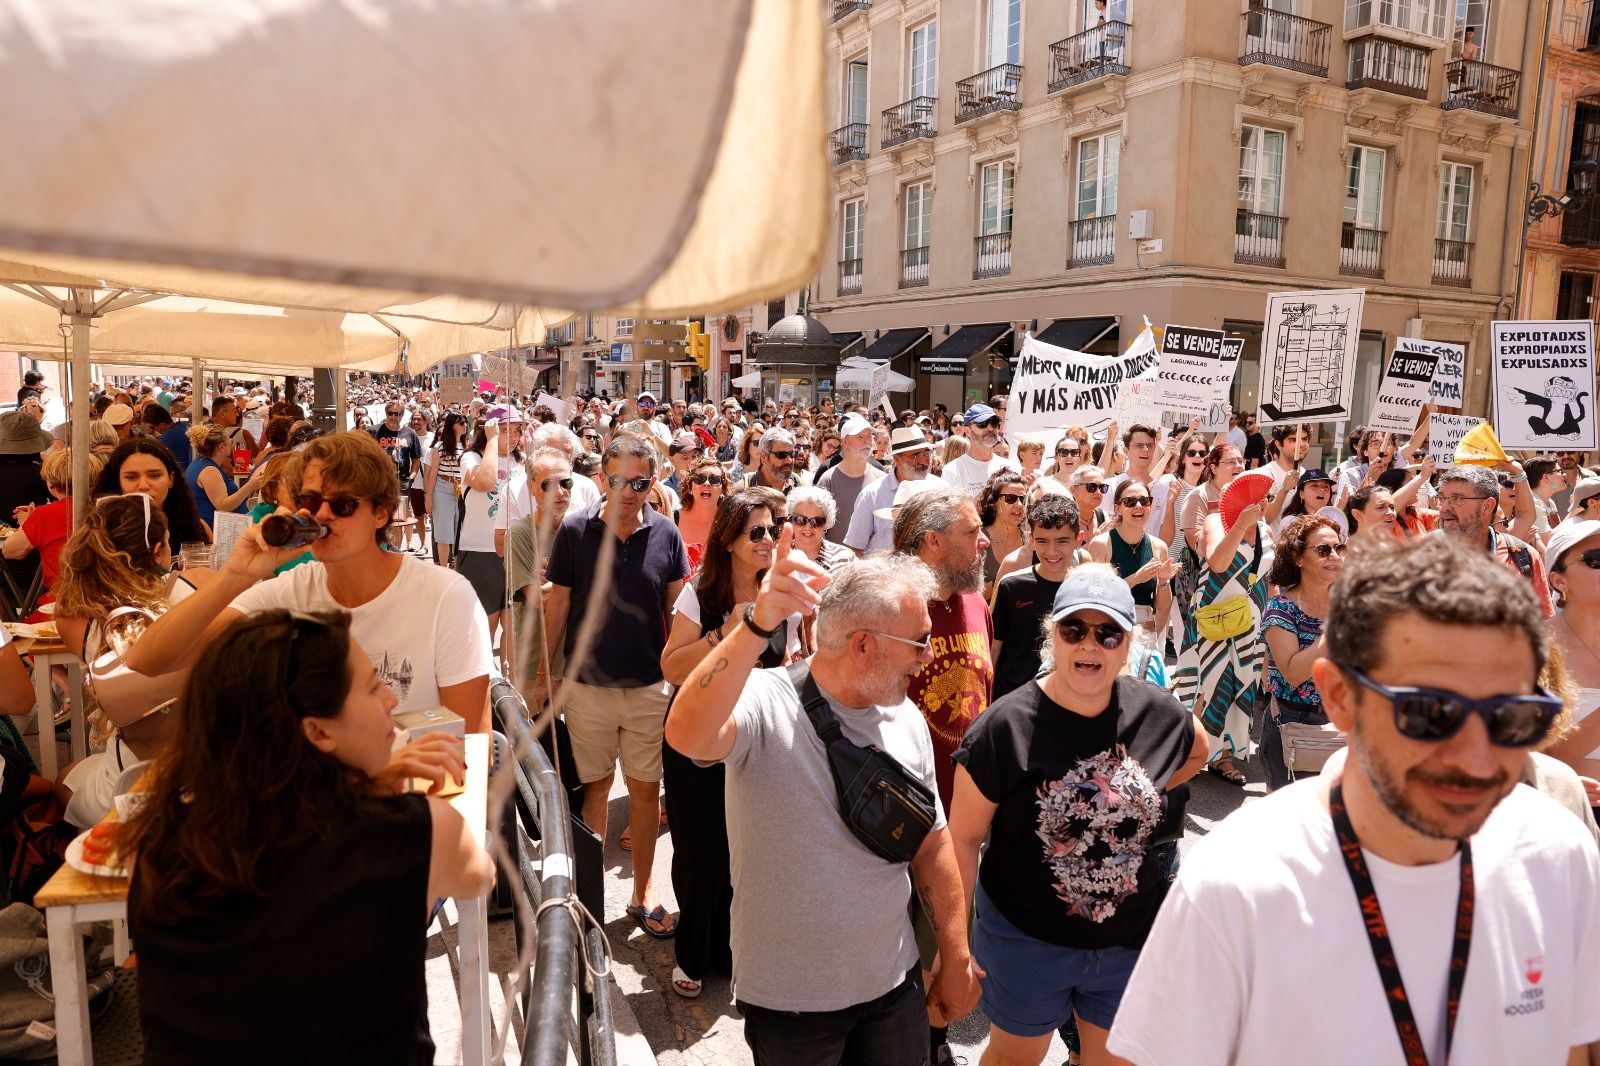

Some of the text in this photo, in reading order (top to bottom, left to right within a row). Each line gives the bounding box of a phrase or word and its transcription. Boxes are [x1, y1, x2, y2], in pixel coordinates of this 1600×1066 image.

[1499, 331, 1586, 342] EXPLOTADXS
[1166, 333, 1220, 354] SE VENDE
[1500, 344, 1587, 356] EXPROPIADXS
[1170, 358, 1208, 368] LAGUNILLAS
[1391, 357, 1435, 377] SE VENDE
[1501, 357, 1588, 369] EXPULSADXS
[1018, 391, 1028, 414] Y
[1032, 383, 1068, 413] MÁS
[1431, 439, 1442, 448] NO
[1360, 893, 1388, 938] WTF
